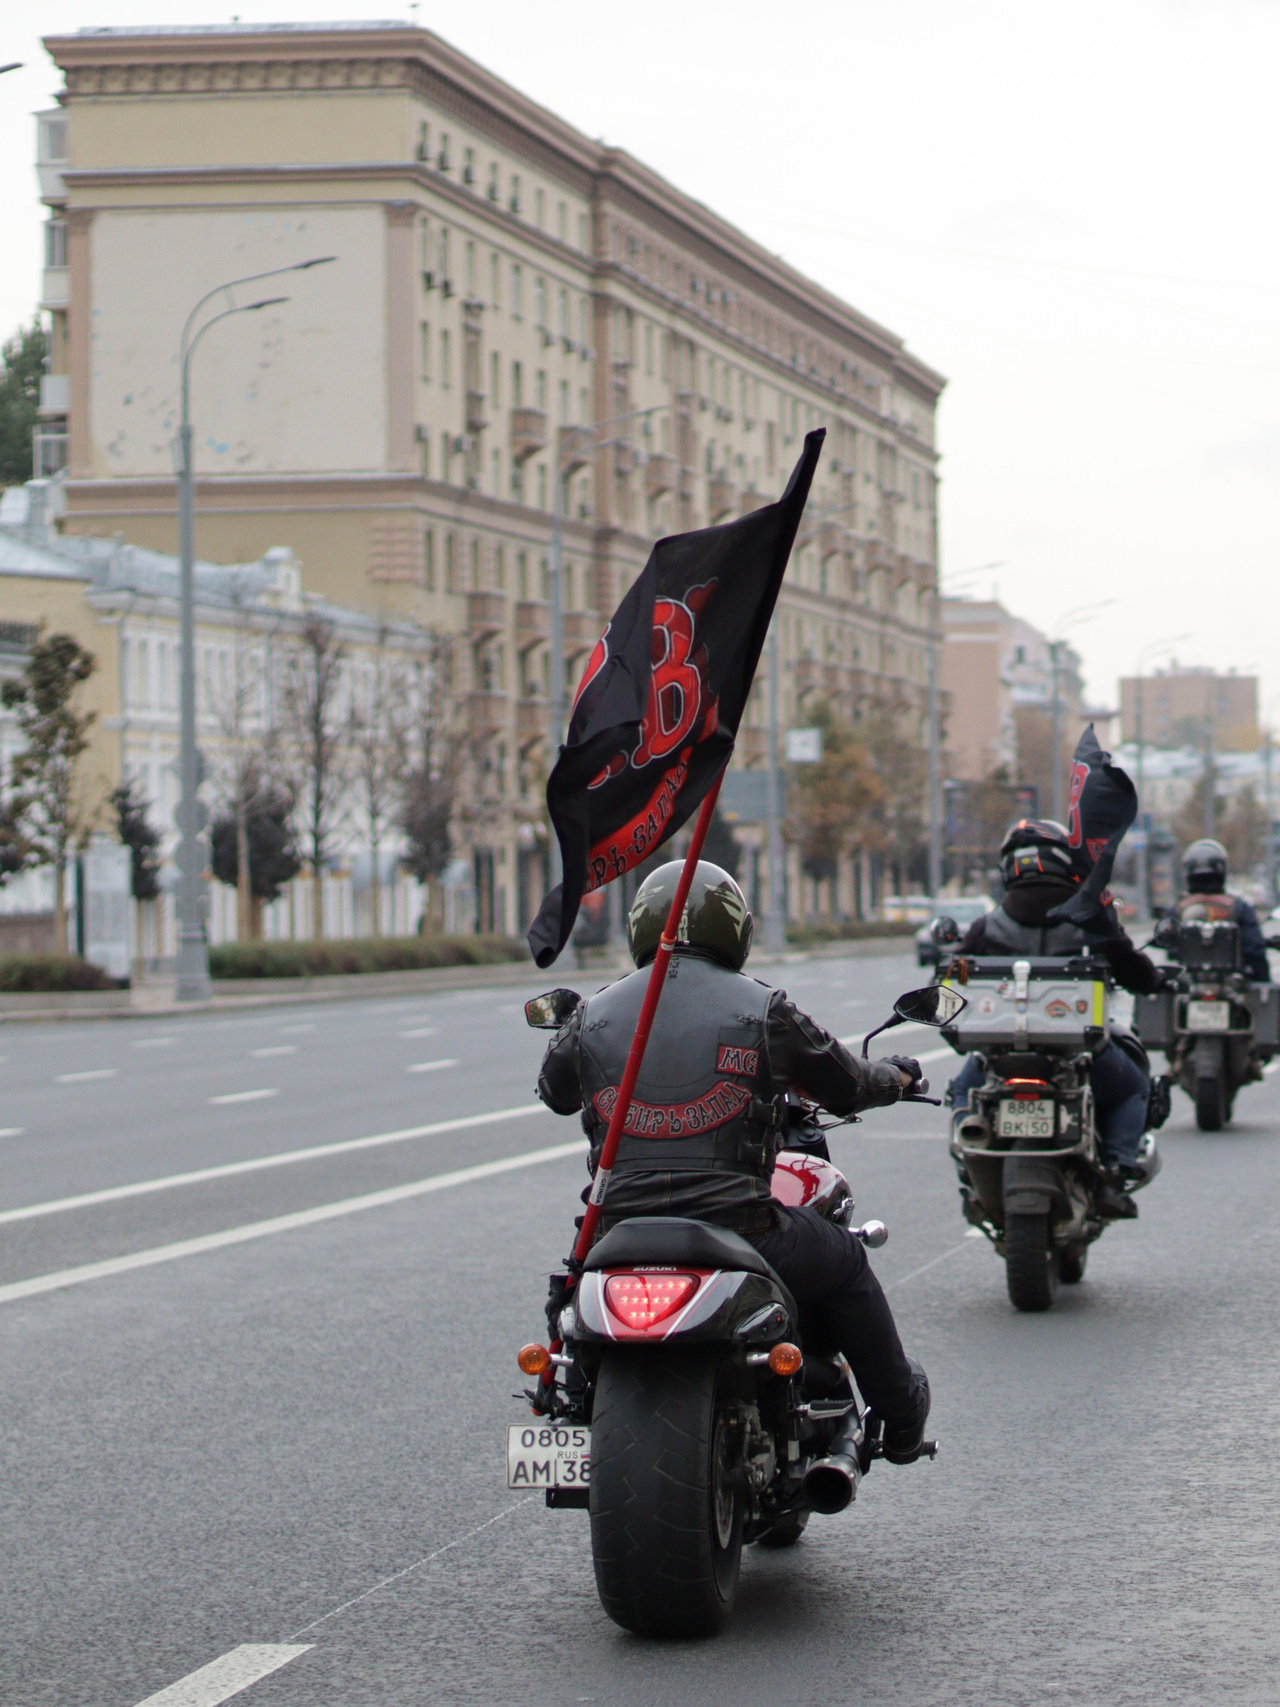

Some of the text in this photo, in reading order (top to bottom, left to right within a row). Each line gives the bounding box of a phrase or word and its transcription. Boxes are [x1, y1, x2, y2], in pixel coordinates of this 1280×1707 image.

[596, 1178, 606, 1204] GRINDA
[521, 1429, 586, 1448] 0805
[558, 1451, 579, 1459] RUS
[562, 1460, 591, 1483] 38
